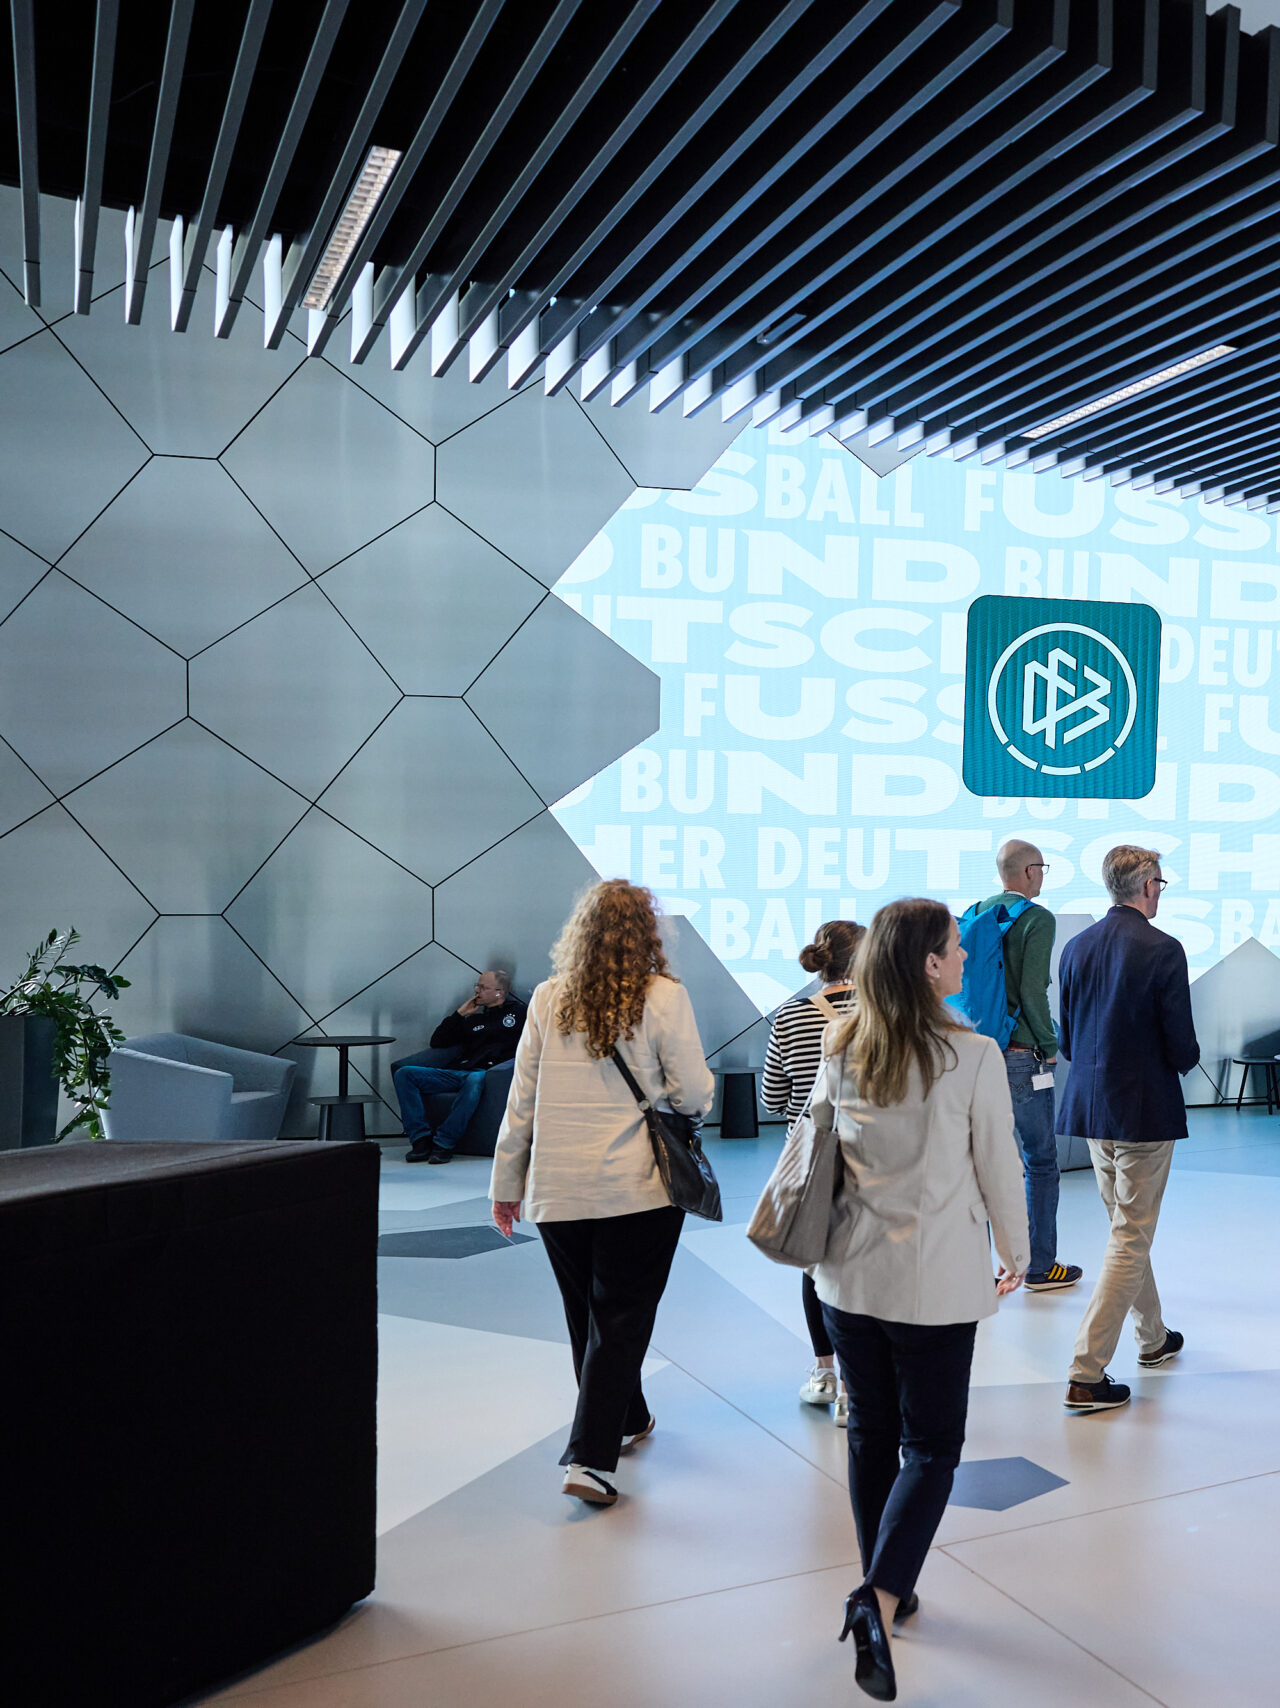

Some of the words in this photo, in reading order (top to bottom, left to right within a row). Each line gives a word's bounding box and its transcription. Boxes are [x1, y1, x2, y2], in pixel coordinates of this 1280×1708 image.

[619, 450, 925, 528] SBALL
[641, 523, 981, 603] BUND
[620, 748, 960, 817] BUND
